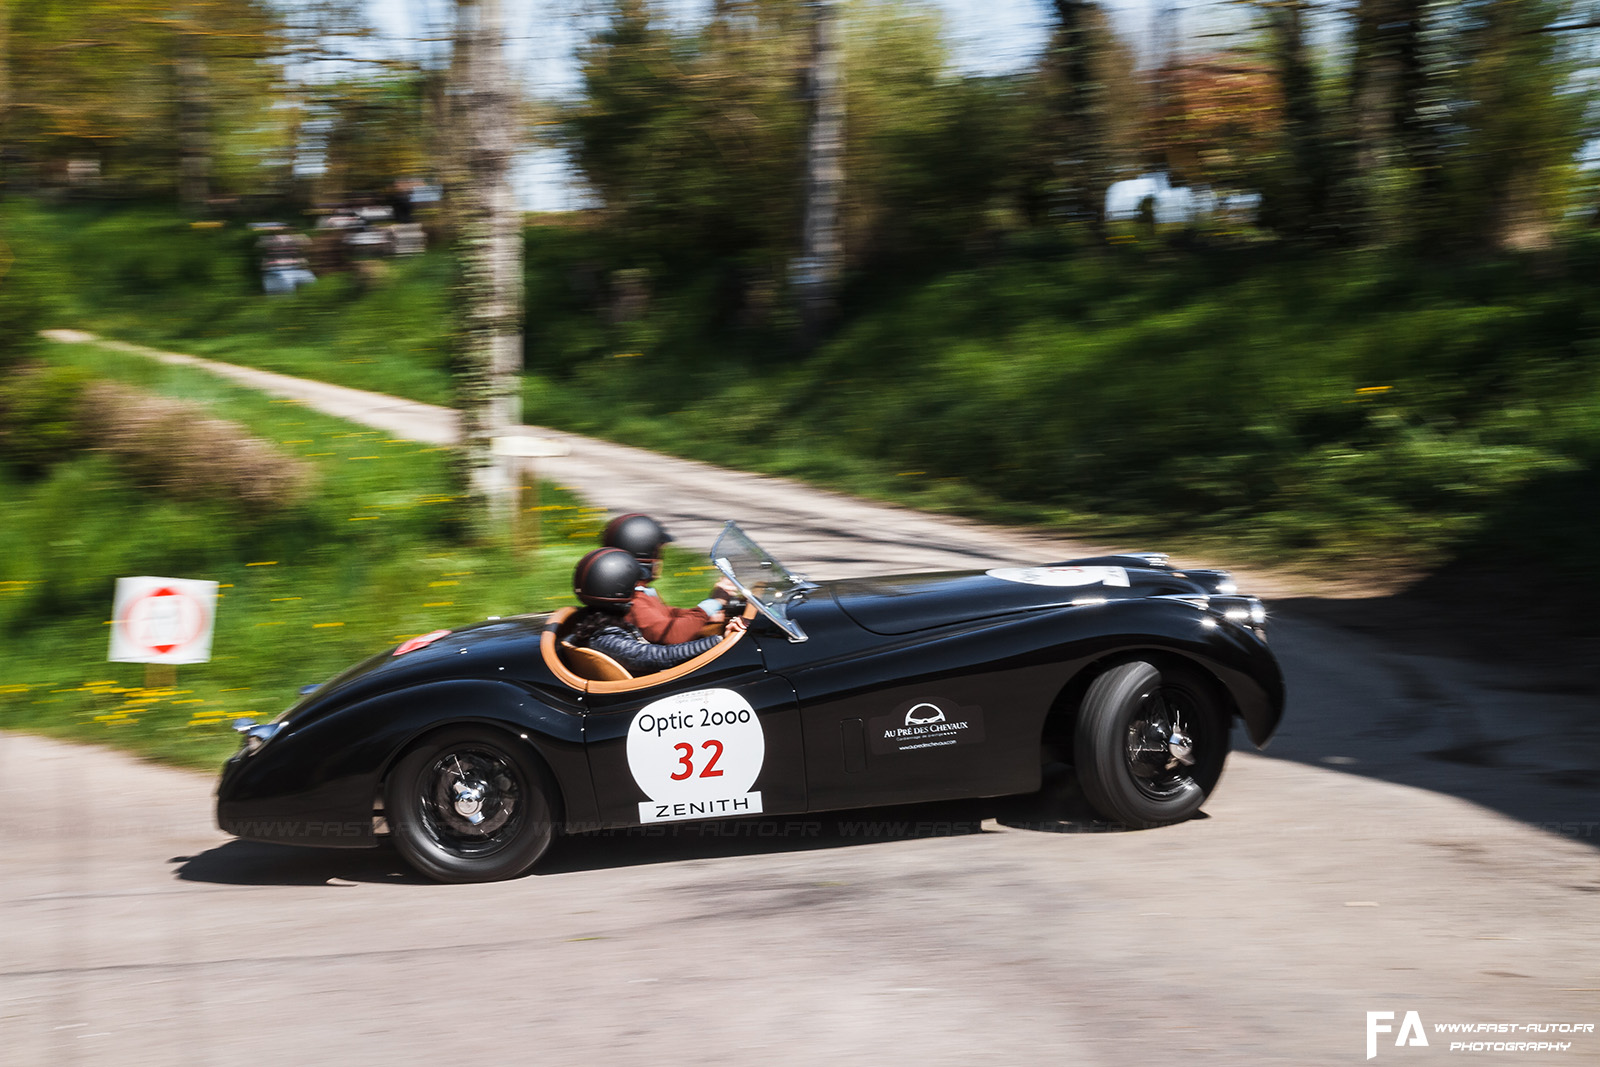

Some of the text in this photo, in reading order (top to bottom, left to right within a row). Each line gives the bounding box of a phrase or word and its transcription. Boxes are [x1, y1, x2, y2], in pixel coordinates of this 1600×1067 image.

[638, 708, 750, 737] Optic 2000
[884, 722, 968, 738] AU PRÉ DES CHEVAUX
[670, 739, 724, 781] 32
[656, 798, 749, 818] ZENITH
